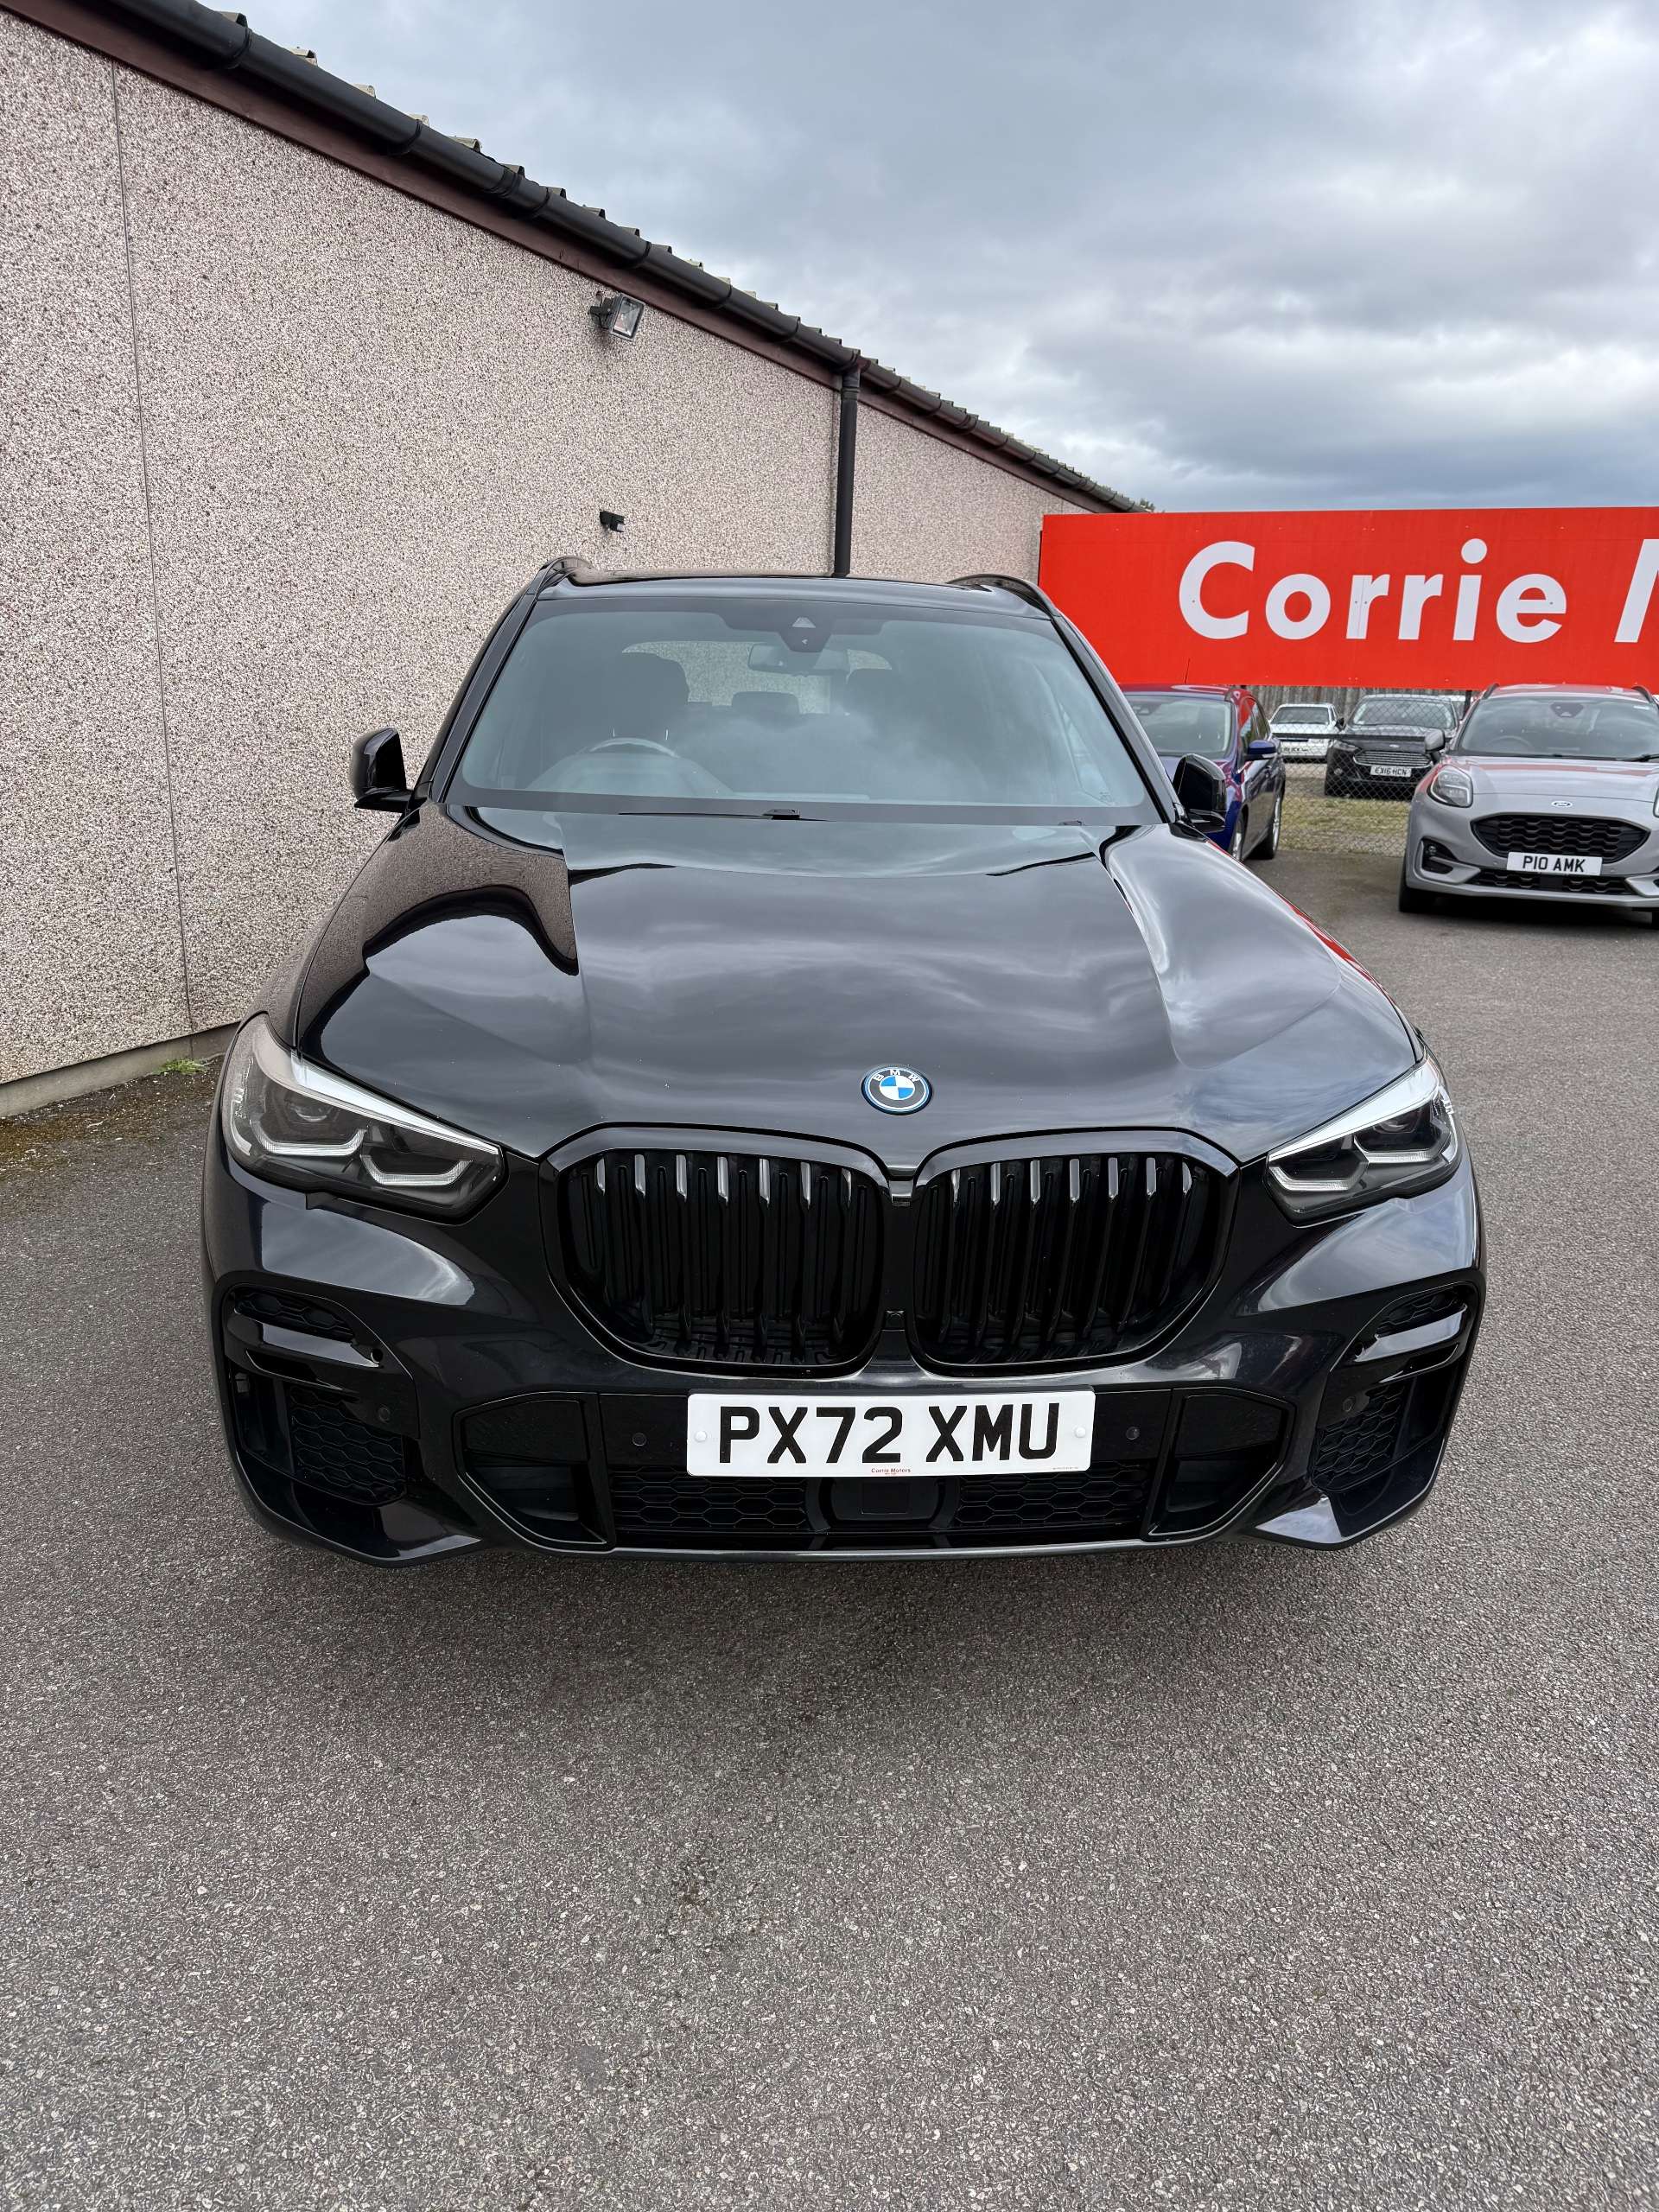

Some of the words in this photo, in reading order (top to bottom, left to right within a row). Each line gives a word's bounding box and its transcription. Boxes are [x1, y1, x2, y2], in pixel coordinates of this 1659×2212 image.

[1179, 537, 1567, 643] Corrie
[1522, 855, 1548, 870] P10
[1553, 857, 1586, 873] AMK
[873, 1070, 920, 1082] BMW
[720, 1406, 903, 1463] PX72
[925, 1403, 1059, 1462] XMU
